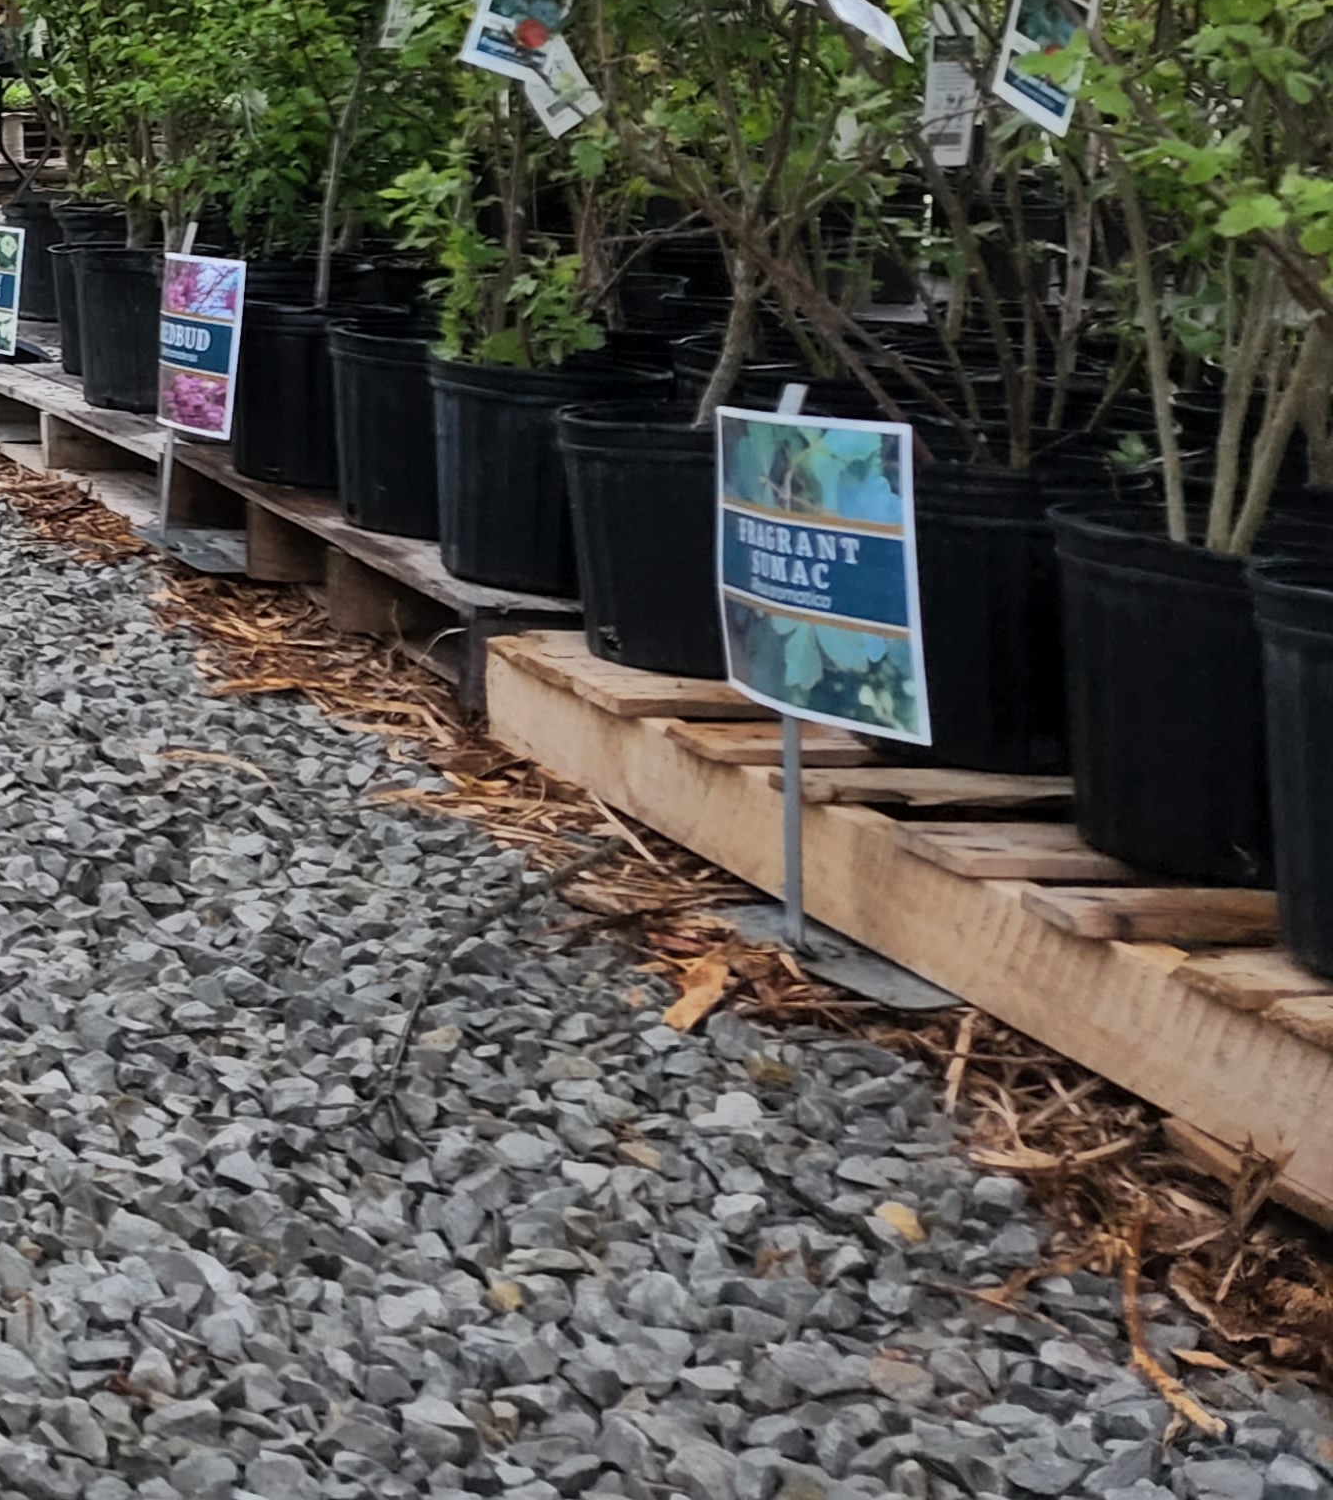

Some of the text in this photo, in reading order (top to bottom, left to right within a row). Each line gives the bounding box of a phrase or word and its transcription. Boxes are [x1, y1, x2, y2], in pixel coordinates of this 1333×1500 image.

[160, 320, 211, 351] EDBUD
[738, 517, 860, 565] FRAGRANT
[750, 549, 831, 590] SUMAC
